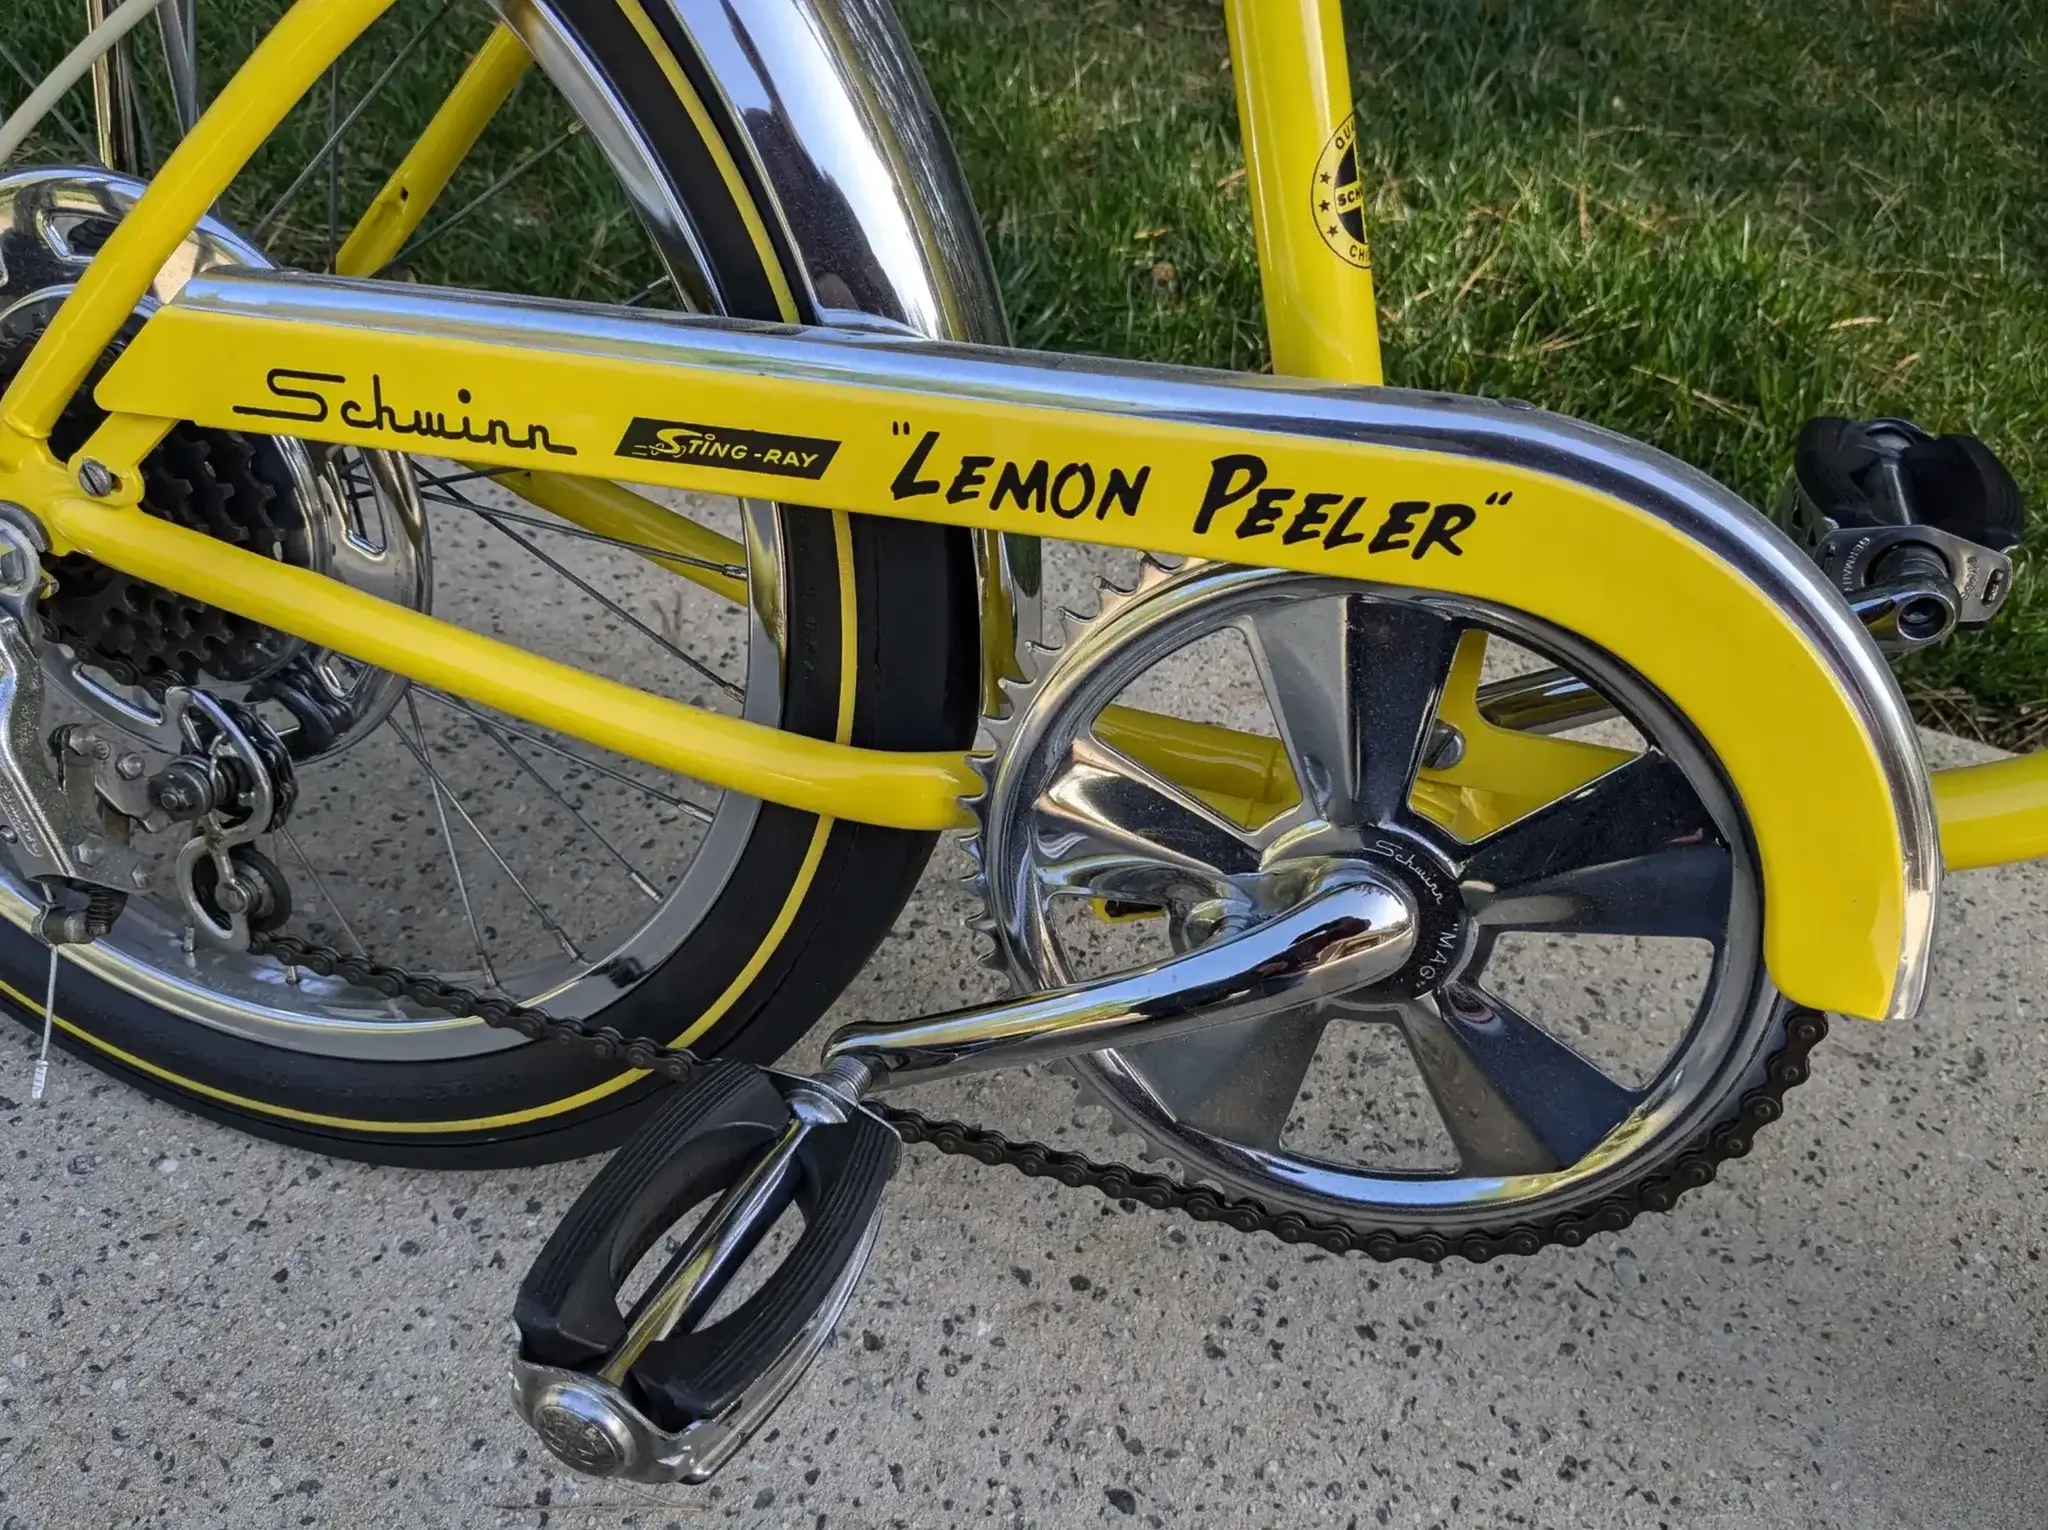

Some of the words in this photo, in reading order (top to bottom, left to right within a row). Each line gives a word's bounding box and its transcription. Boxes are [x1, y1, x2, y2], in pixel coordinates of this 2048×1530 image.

[1348, 243, 1372, 263] CHI
[231, 367, 578, 456] Schwinn
[890, 420, 1152, 521] "LEMON
[1193, 453, 1513, 561] PEELER"
[1361, 838, 1444, 906] Schwinn
